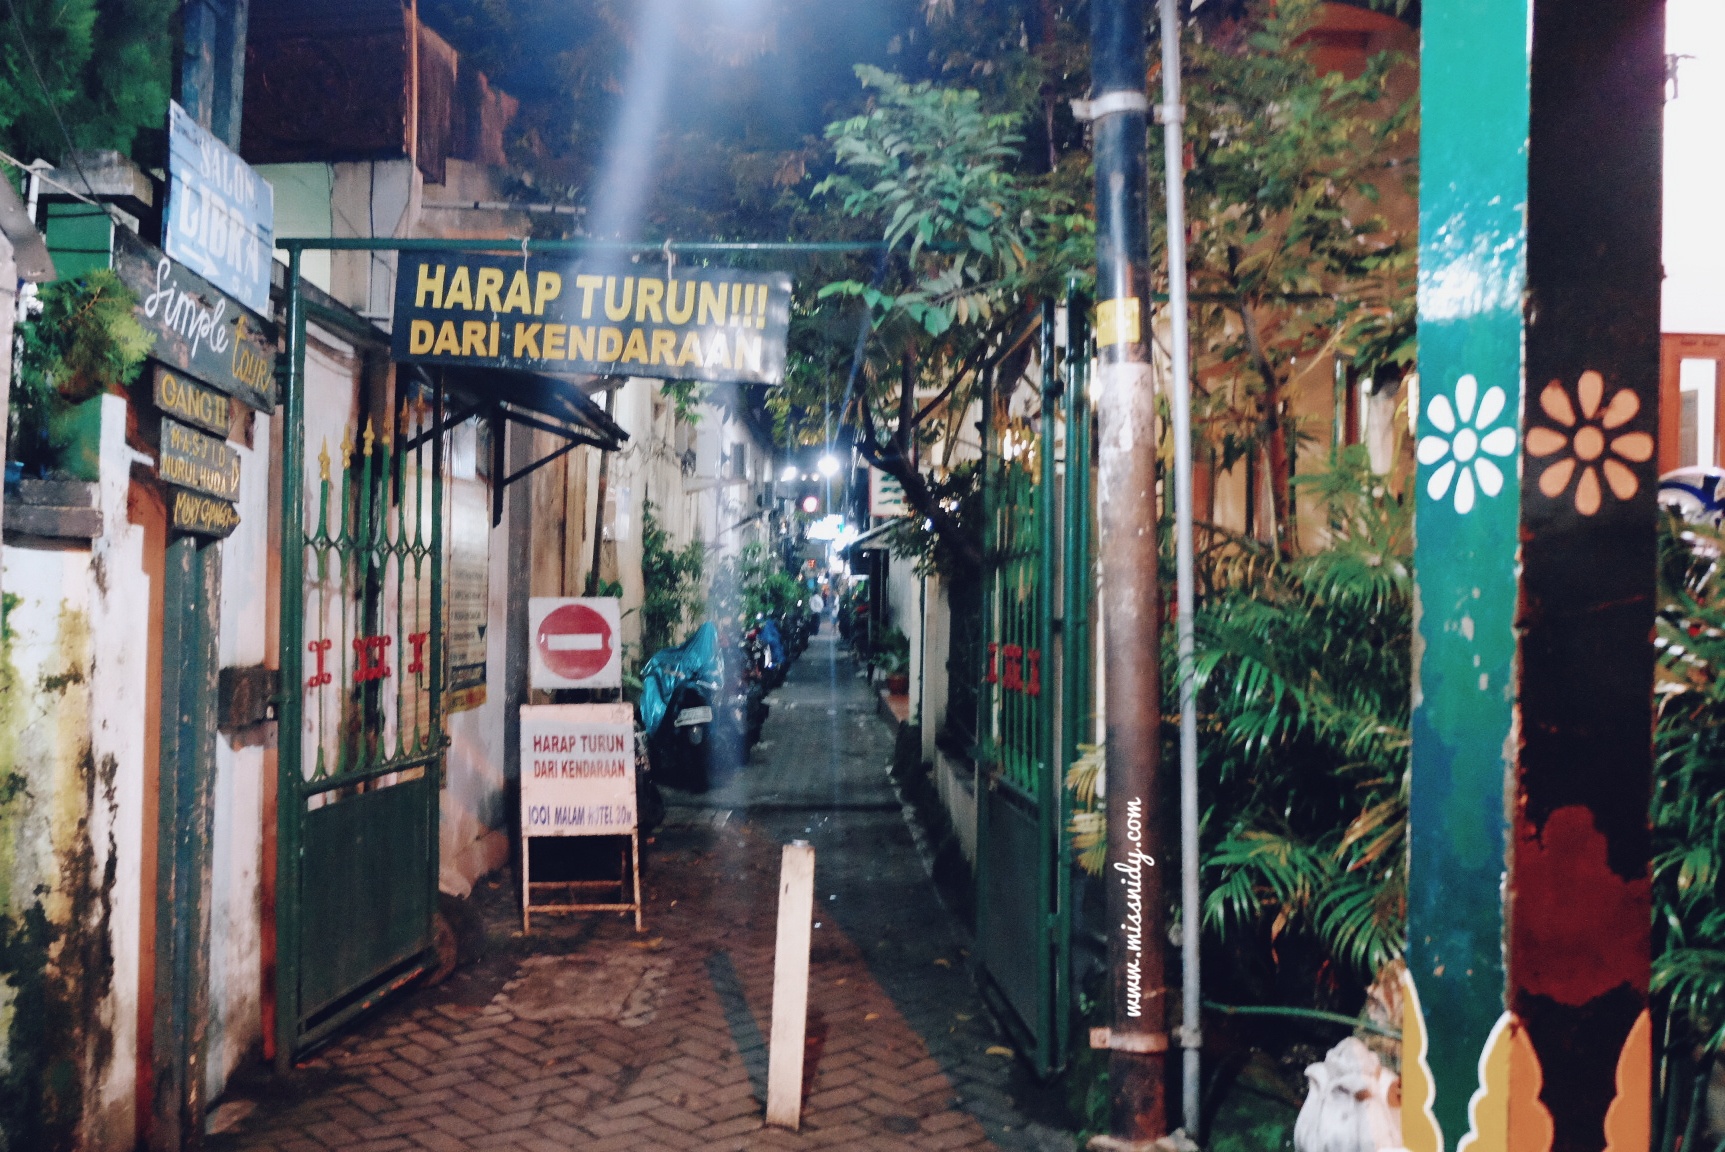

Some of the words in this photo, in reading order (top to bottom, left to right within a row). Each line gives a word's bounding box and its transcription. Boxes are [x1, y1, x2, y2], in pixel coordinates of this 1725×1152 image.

[200, 137, 255, 209] SALON
[179, 169, 260, 286] LIBRA
[144, 257, 228, 359] Simple
[415, 263, 562, 315] HARAP
[576, 274, 768, 329] TURUN!!!
[409, 319, 500, 358] DARI
[513, 322, 762, 372] KENDARAAN
[162, 374, 213, 423] GANG
[171, 427, 226, 468] MASJID
[162, 456, 198, 487] NURUL
[199, 470, 227, 494] HUDA
[533, 735, 576, 752] HARAP
[580, 734, 625, 753] TURUN
[534, 760, 558, 778] DARI
[561, 760, 625, 778] KENDARAAN
[529, 805, 550, 825] 1001
[554, 806, 585, 825] MALAM
